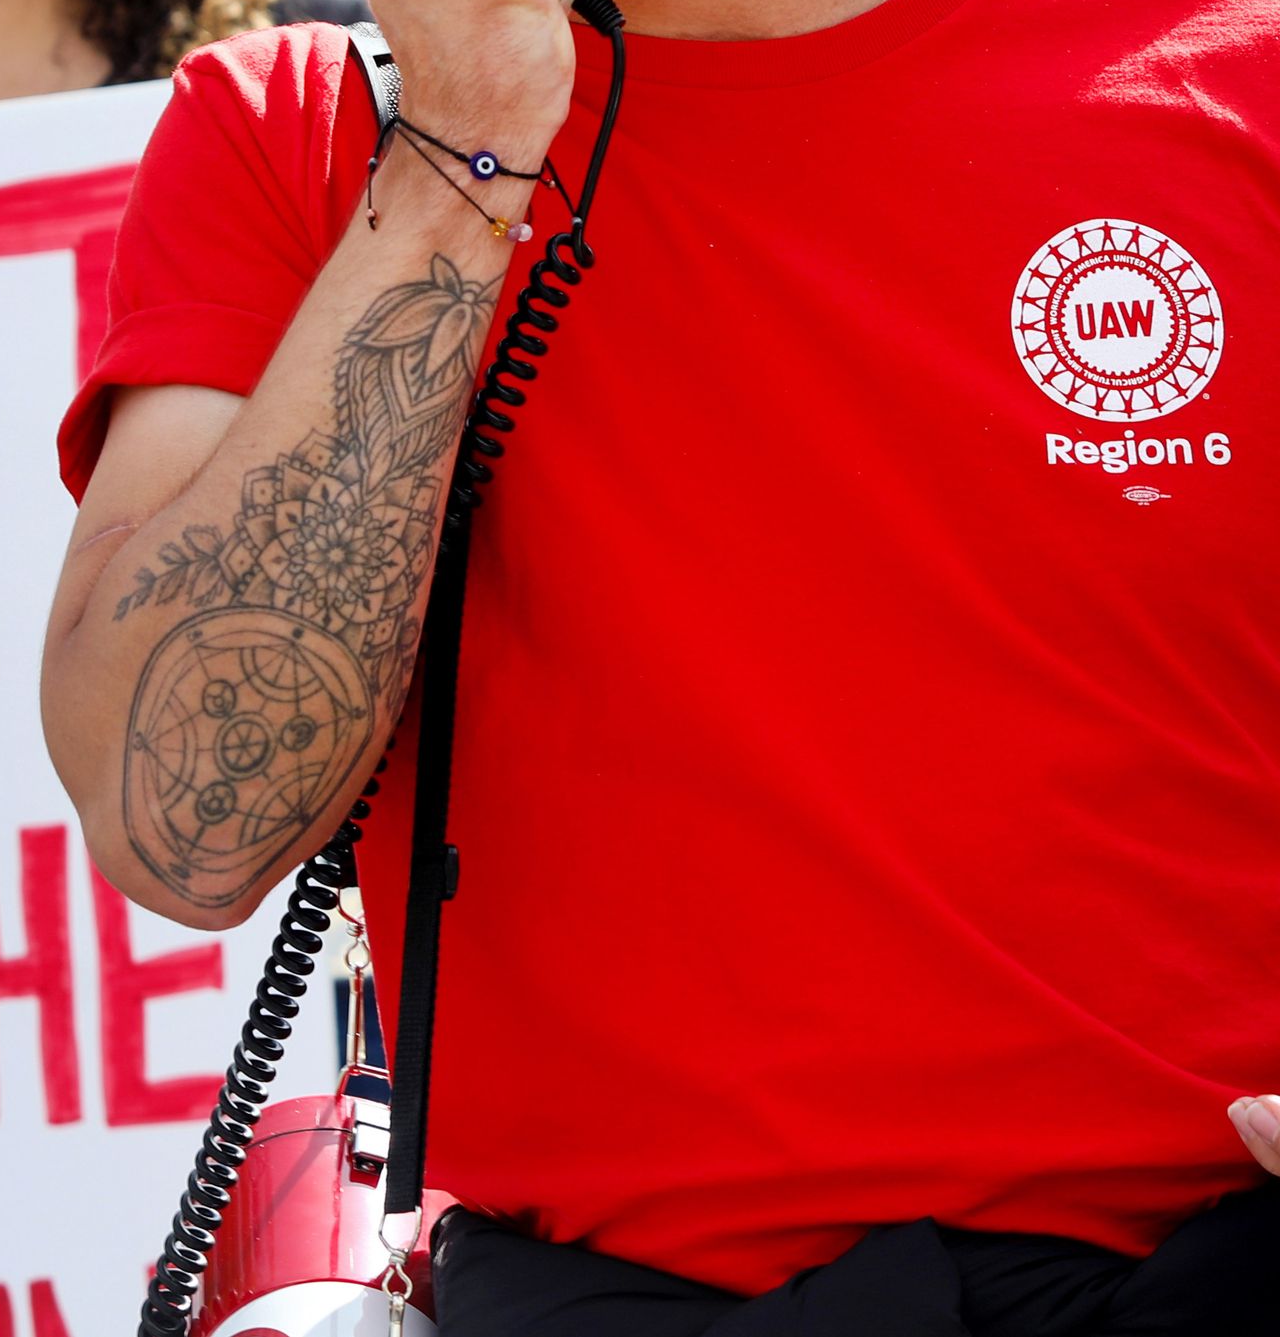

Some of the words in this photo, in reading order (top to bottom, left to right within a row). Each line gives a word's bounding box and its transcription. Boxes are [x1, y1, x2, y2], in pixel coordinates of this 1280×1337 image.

[1073, 254, 1111, 276] AMERICA
[1113, 254, 1146, 268] UNITED
[1062, 272, 1074, 285] OF
[1050, 283, 1066, 325] WORKERS
[1075, 299, 1155, 341] UAW
[1050, 329, 1083, 373] IMPLEMENT
[1165, 318, 1187, 365] AEROSPACE
[1083, 369, 1149, 386] AGRICULTURAL
[1149, 362, 1168, 379] AND
[1045, 429, 1194, 474] Region
[1203, 432, 1232, 466] 6
